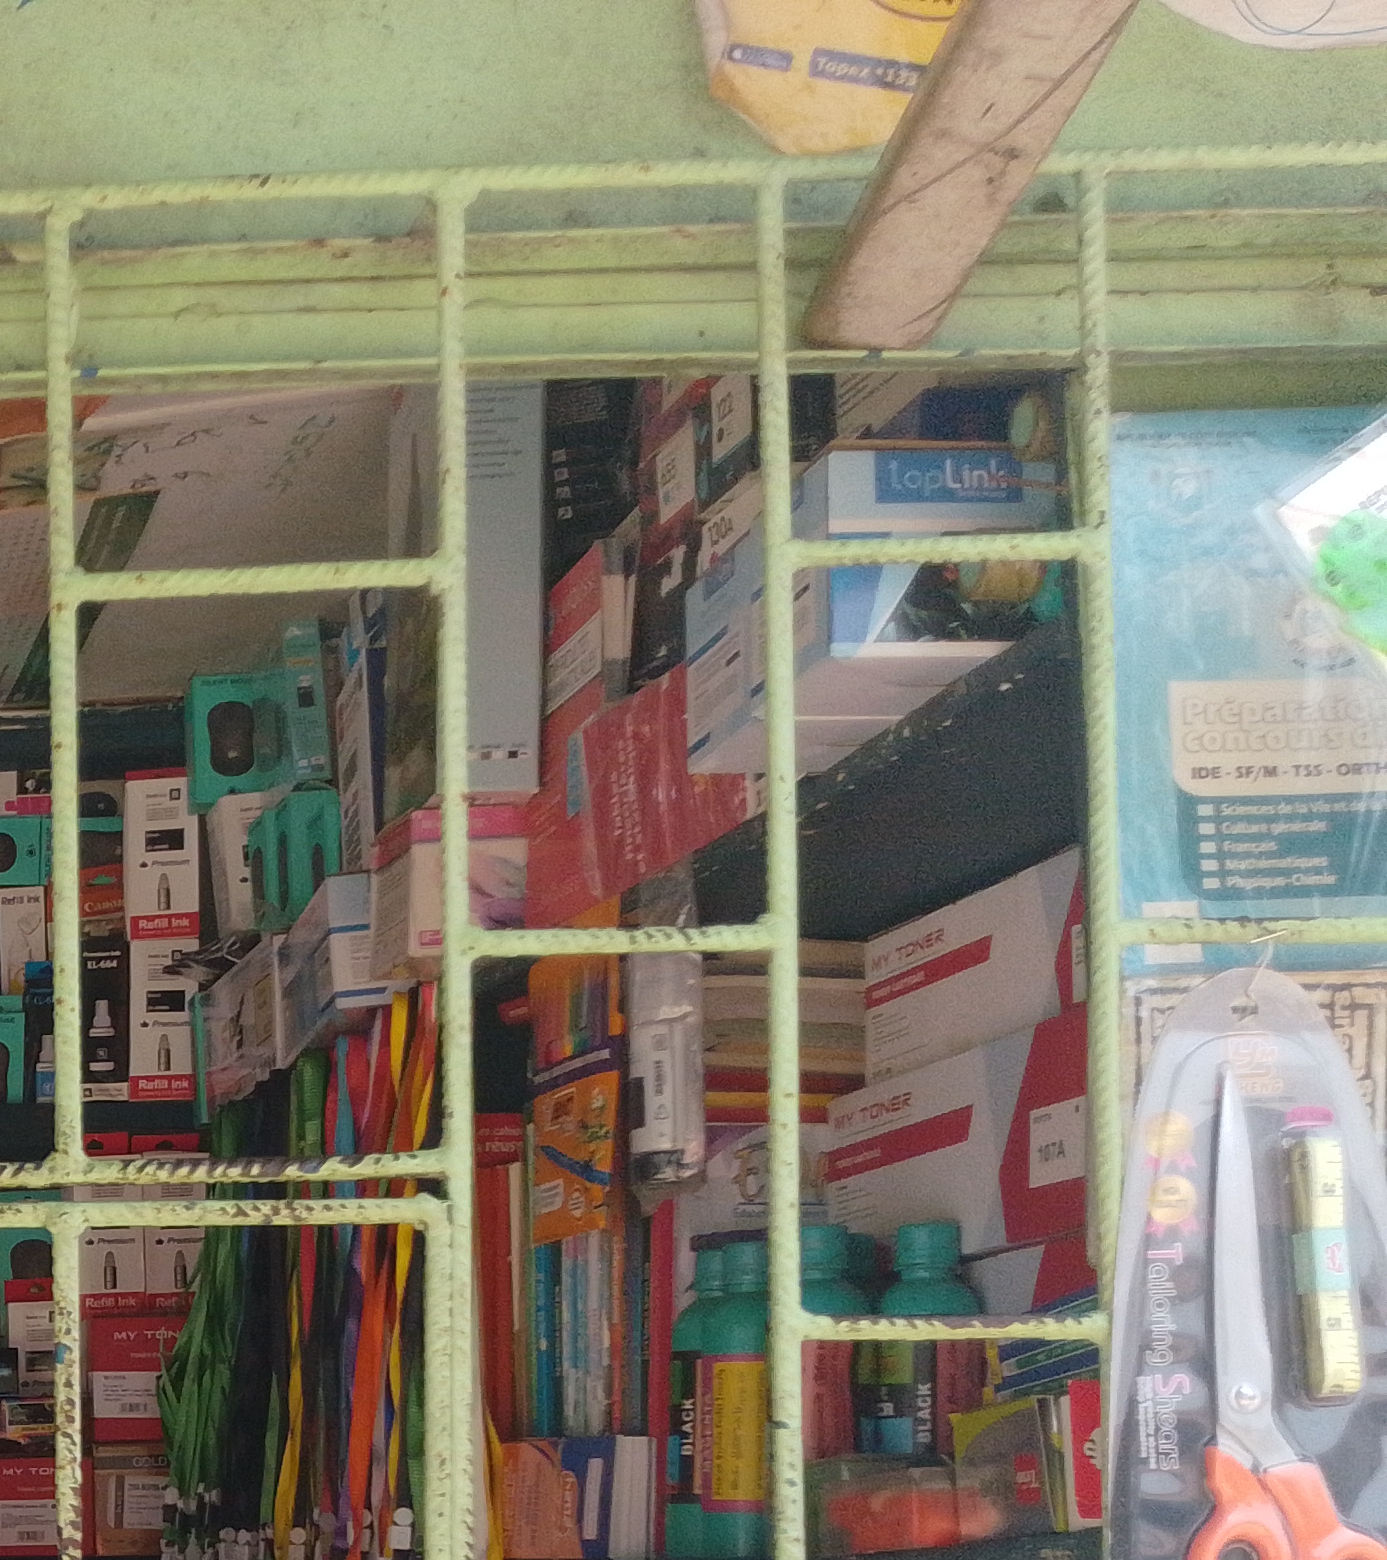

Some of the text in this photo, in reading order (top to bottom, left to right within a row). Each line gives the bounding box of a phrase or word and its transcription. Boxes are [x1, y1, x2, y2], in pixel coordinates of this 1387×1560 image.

[1191, 764, 1323, 783] IDE SF/M TSS
[138, 915, 190, 930] Refill Ink
[899, 927, 946, 960] TONER
[138, 1078, 189, 1091] Refill Ink
[833, 1091, 913, 1130] MY TONER
[113, 1330, 137, 1342] MY
[1134, 1242, 1191, 1472] Tailoring Shears
[917, 1381, 933, 1443] BLACK
[680, 1397, 695, 1457] BLACK
[132, 1456, 167, 1467] GOLD
[2, 1467, 24, 1476] MY
